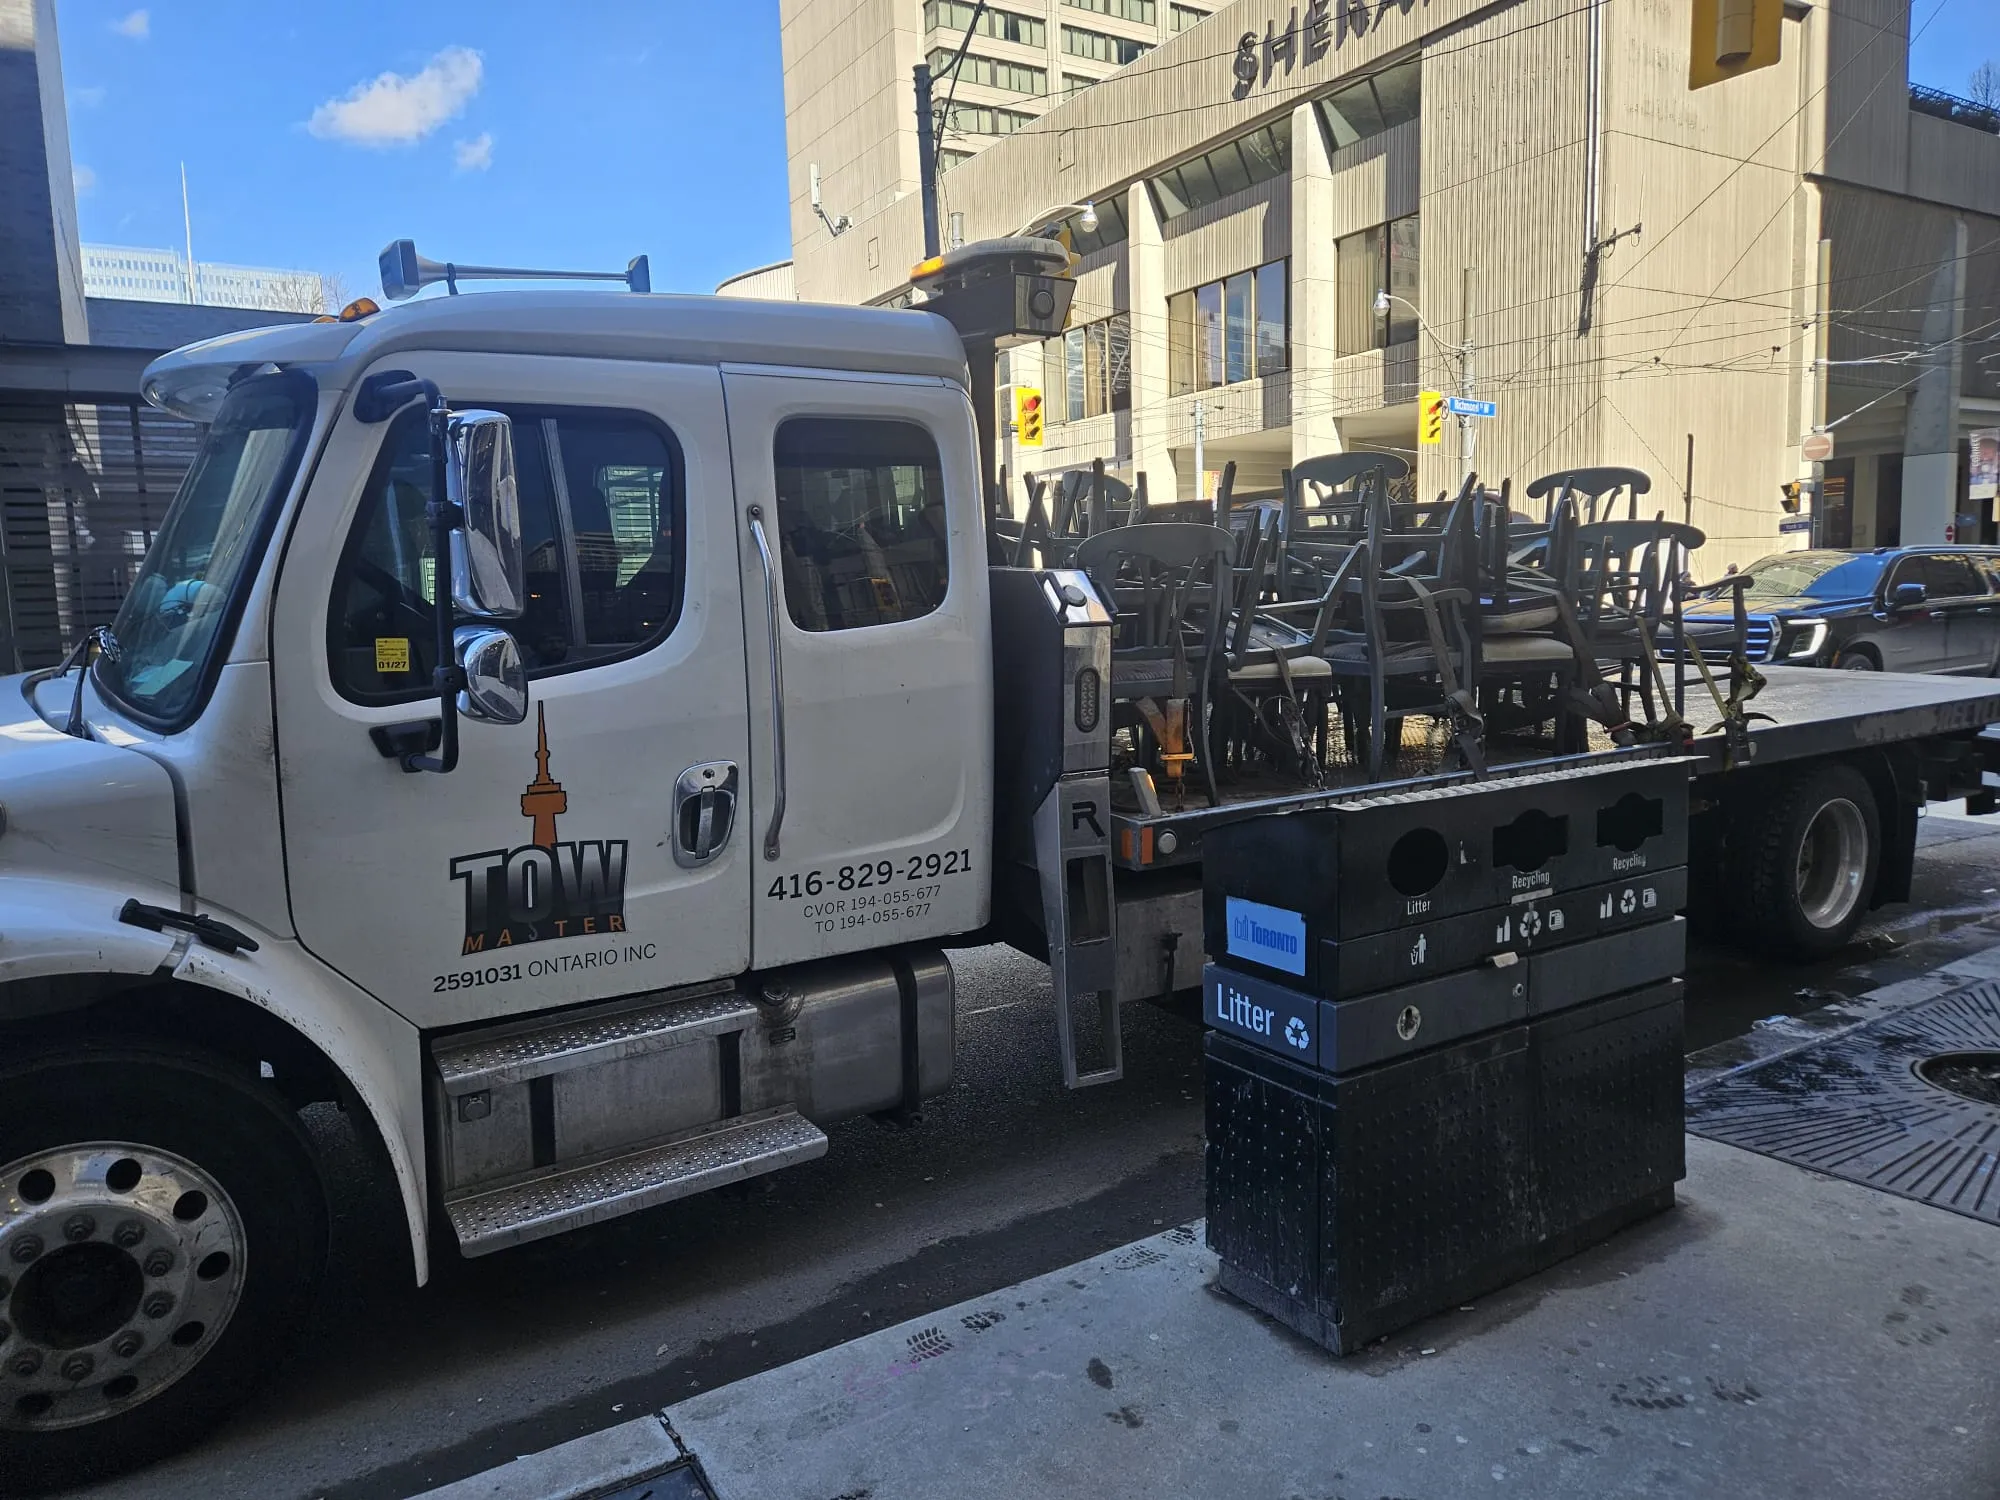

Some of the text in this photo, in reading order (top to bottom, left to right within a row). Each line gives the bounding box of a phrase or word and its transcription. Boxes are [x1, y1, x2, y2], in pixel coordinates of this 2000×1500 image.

[378, 661, 407, 669] 01/27
[1072, 801, 1105, 838] R
[450, 840, 628, 932] TOW
[767, 849, 972, 901] 416-829-2921
[1512, 871, 1550, 889] Recycling
[803, 884, 941, 918] CVOR 194-055-677
[815, 903, 931, 934] TO 194-055-677
[1407, 900, 1431, 916] Litter
[433, 943, 657, 992] 2591031 ONTARIO INC
[1217, 983, 1275, 1036] Litter
